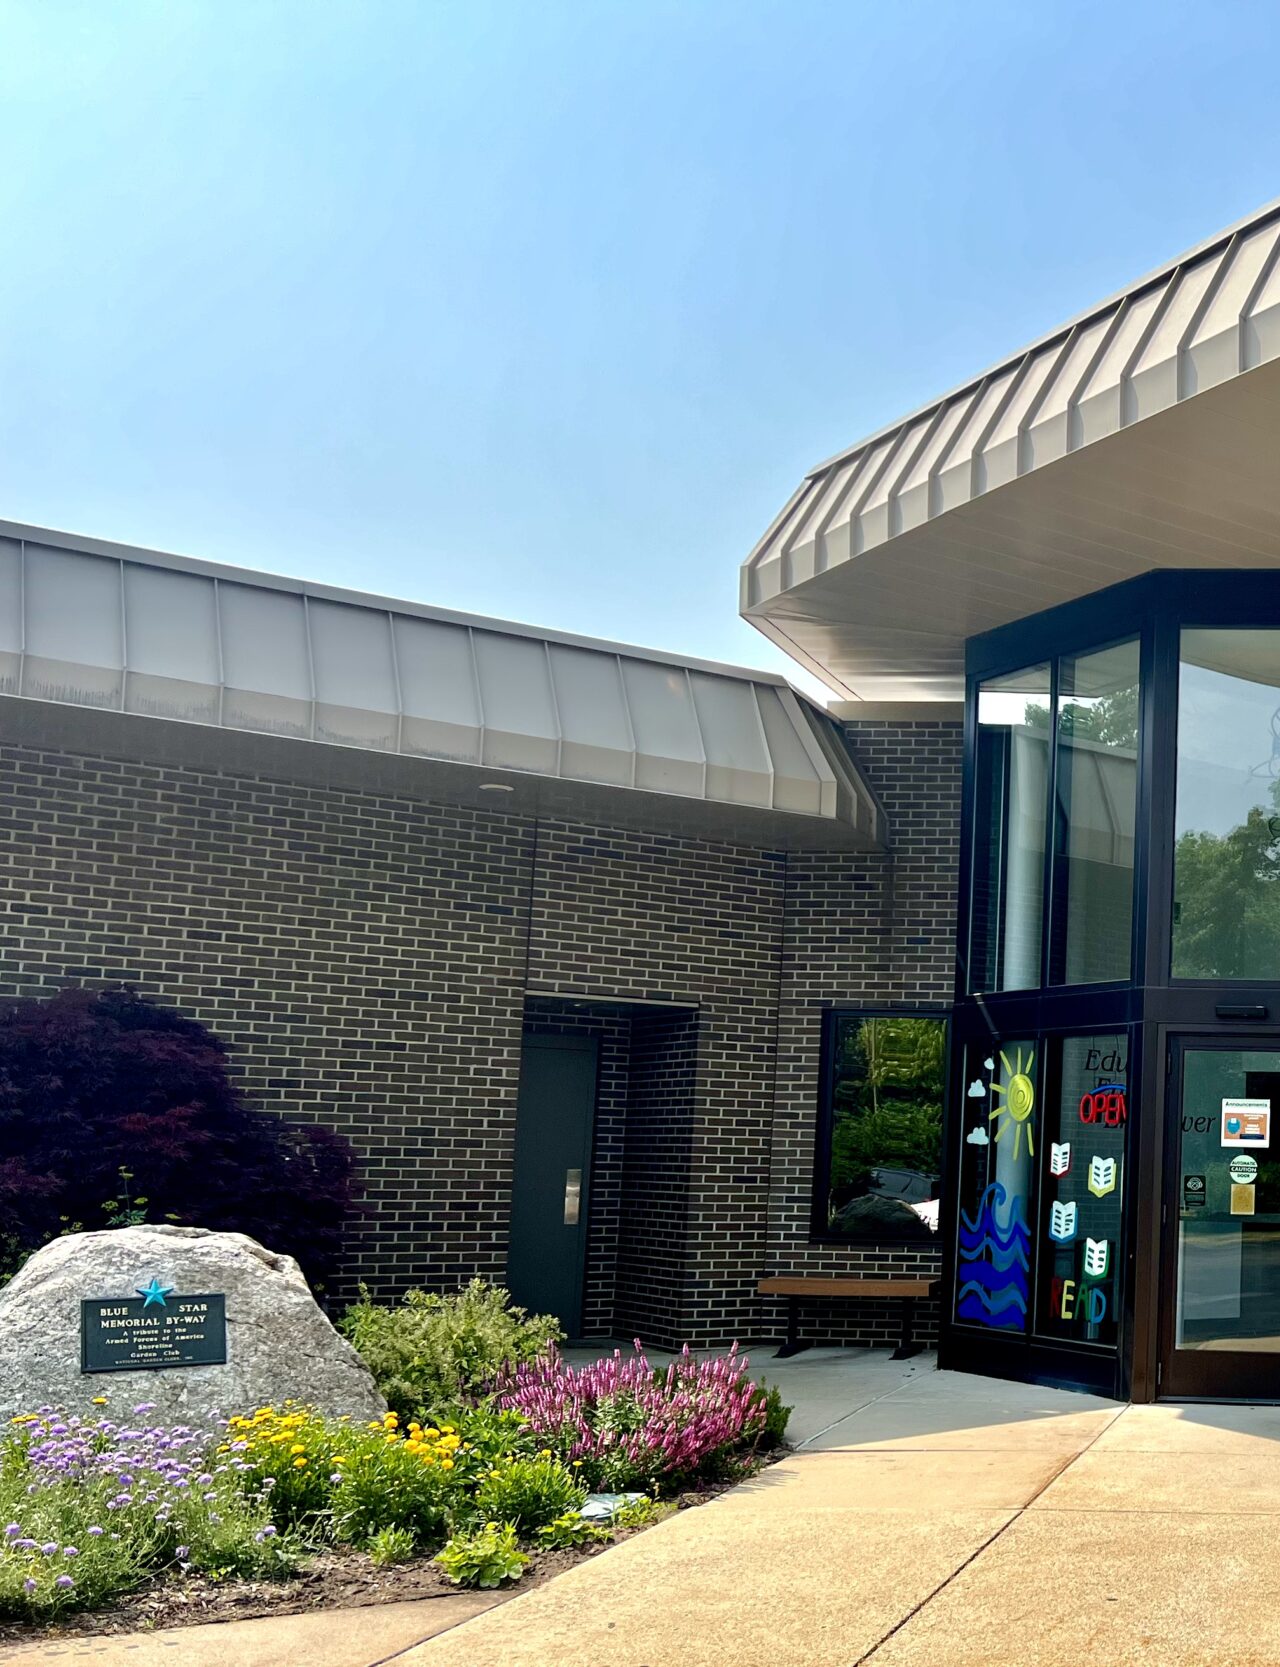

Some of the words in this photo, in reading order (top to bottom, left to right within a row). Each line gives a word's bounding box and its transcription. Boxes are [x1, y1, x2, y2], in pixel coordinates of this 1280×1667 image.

[1080, 1093, 1127, 1124] OPEN
[100, 1307, 129, 1317] BLUE
[179, 1303, 208, 1313] STAR
[1050, 1277, 1107, 1324] READ
[101, 1317, 160, 1329] MEMORIAL
[166, 1315, 206, 1325] BY-WAY
